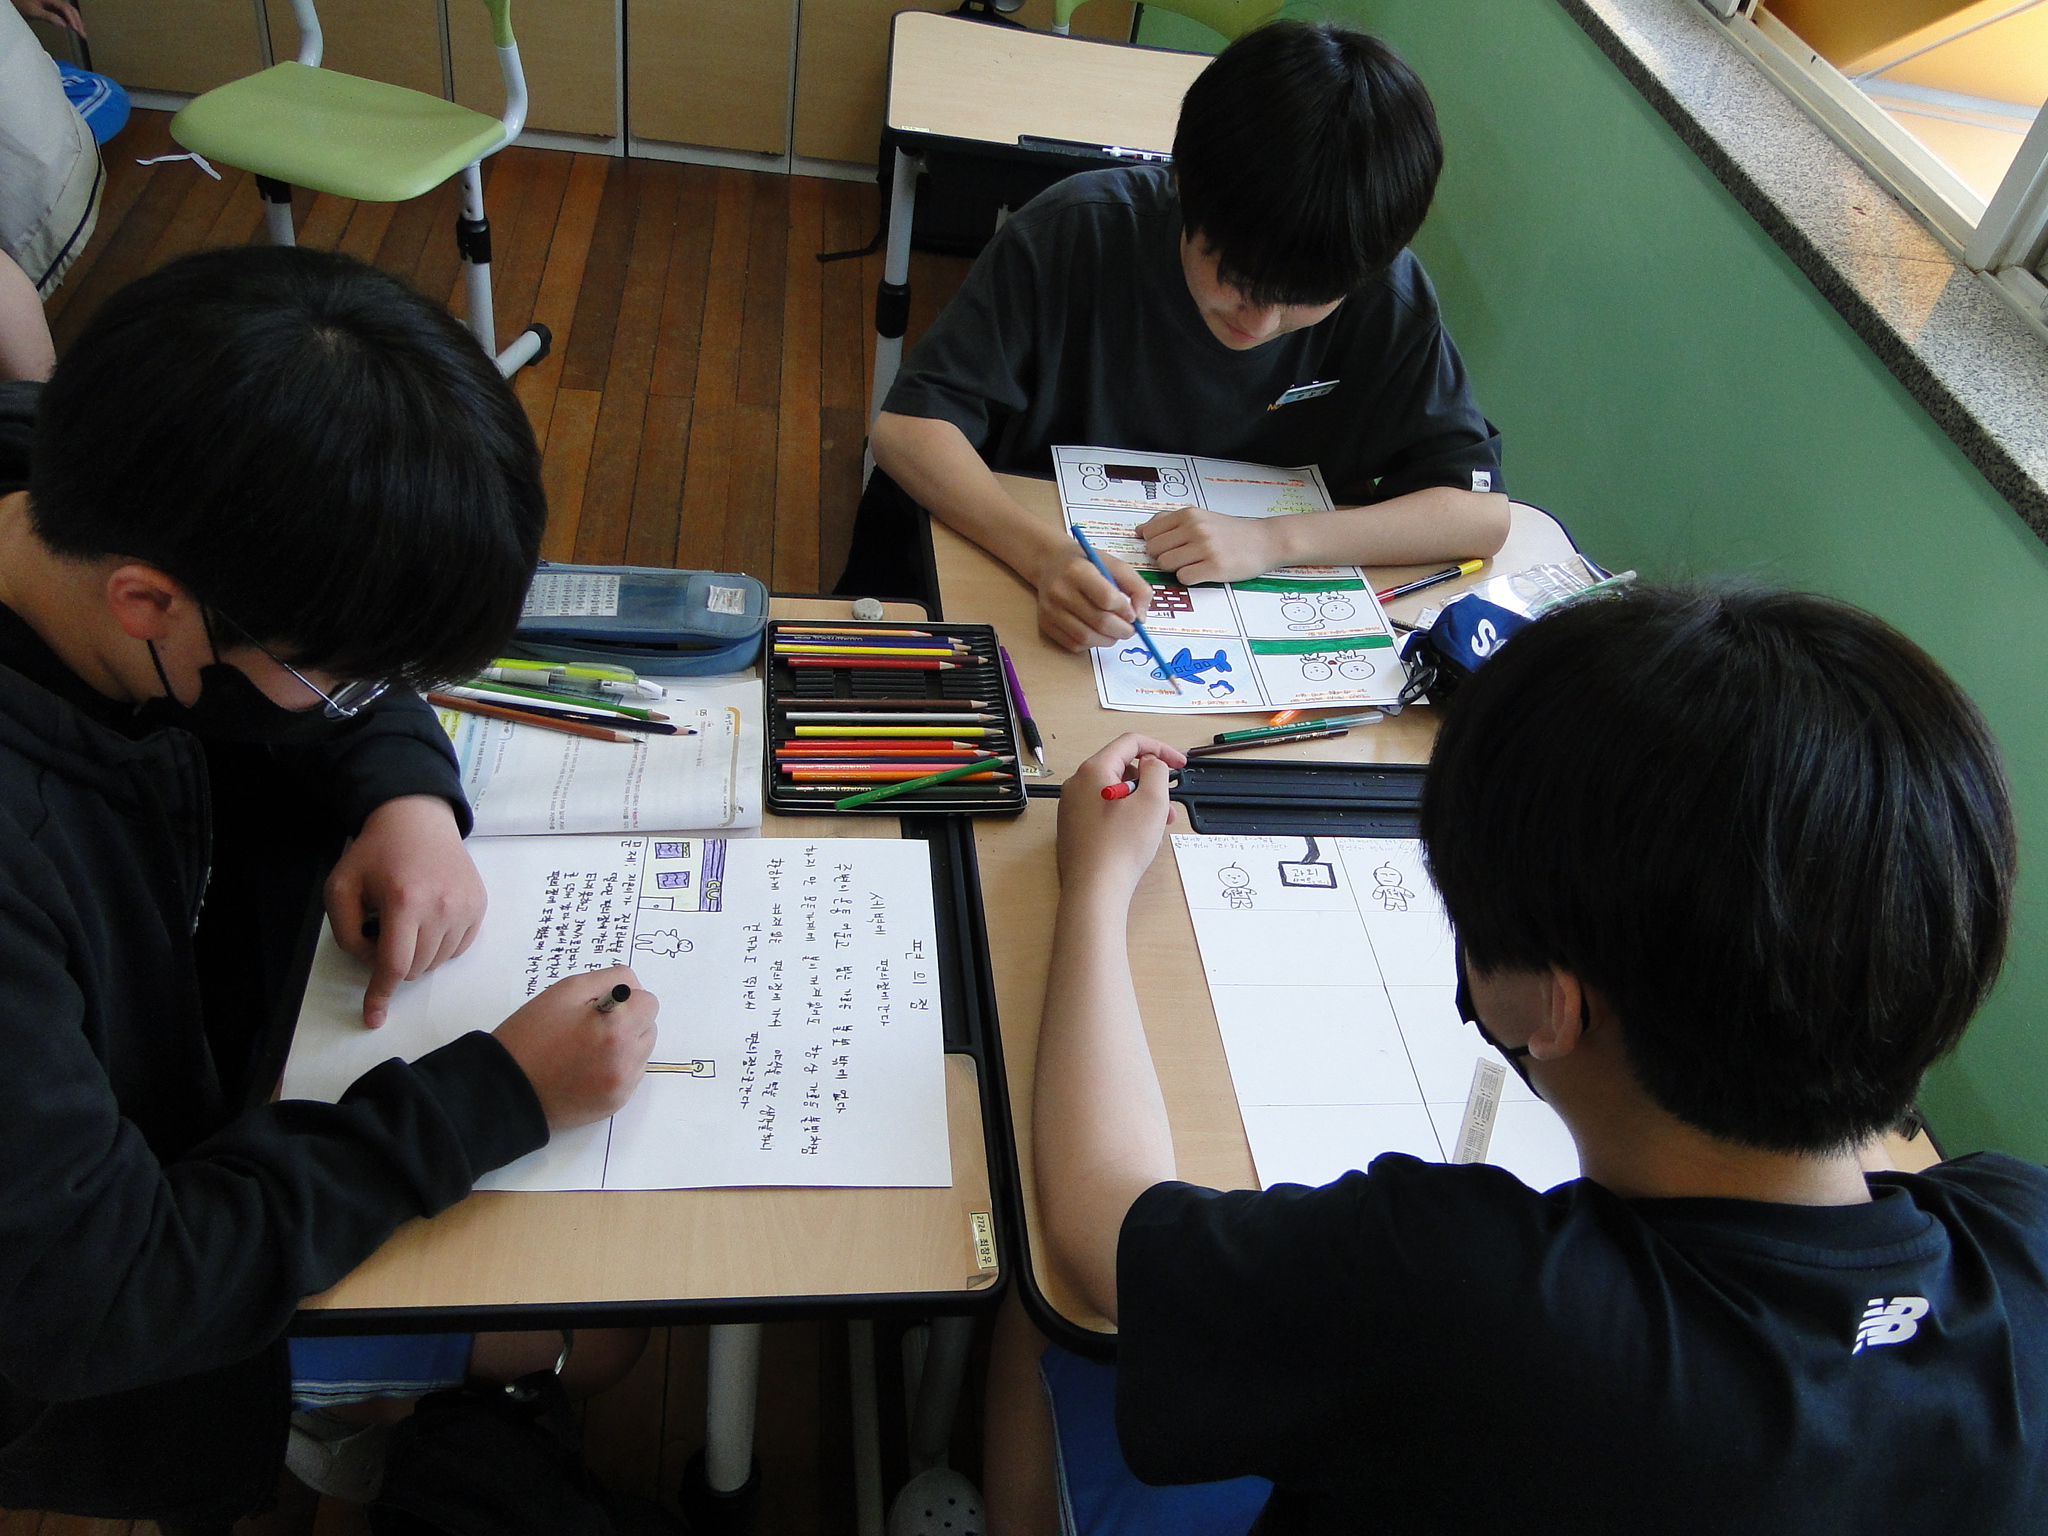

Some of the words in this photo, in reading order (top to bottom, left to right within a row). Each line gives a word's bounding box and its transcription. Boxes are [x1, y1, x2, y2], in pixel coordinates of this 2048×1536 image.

[1471, 618, 1497, 657] S
[705, 880, 722, 901] CU
[832, 1089, 850, 1114] 없다
[976, 1215, 986, 1233] 2724
